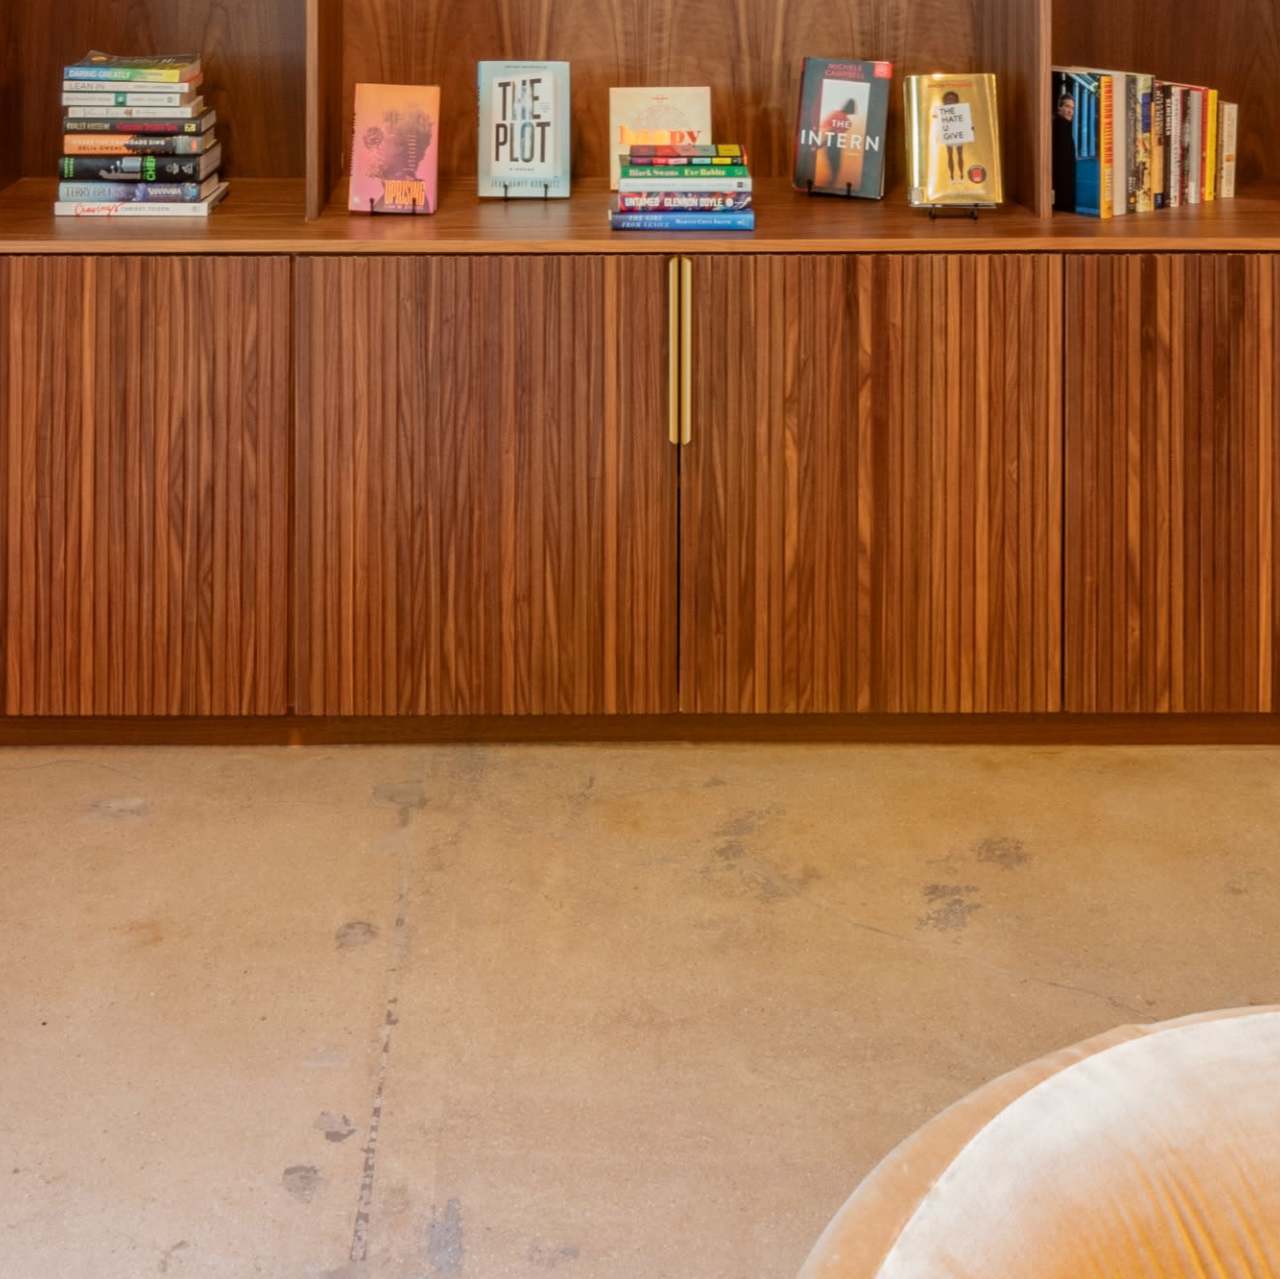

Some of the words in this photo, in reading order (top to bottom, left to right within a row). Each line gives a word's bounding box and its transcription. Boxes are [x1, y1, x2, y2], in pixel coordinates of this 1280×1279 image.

[71, 82, 92, 90] LEAN
[939, 107, 956, 115] THE
[941, 114, 963, 122] HATE
[832, 119, 851, 129] THE
[800, 128, 880, 152] INTERN
[943, 131, 963, 140] GIVE
[495, 122, 551, 163] PLOT
[629, 168, 650, 177] Black
[700, 197, 723, 207] DOYLE
